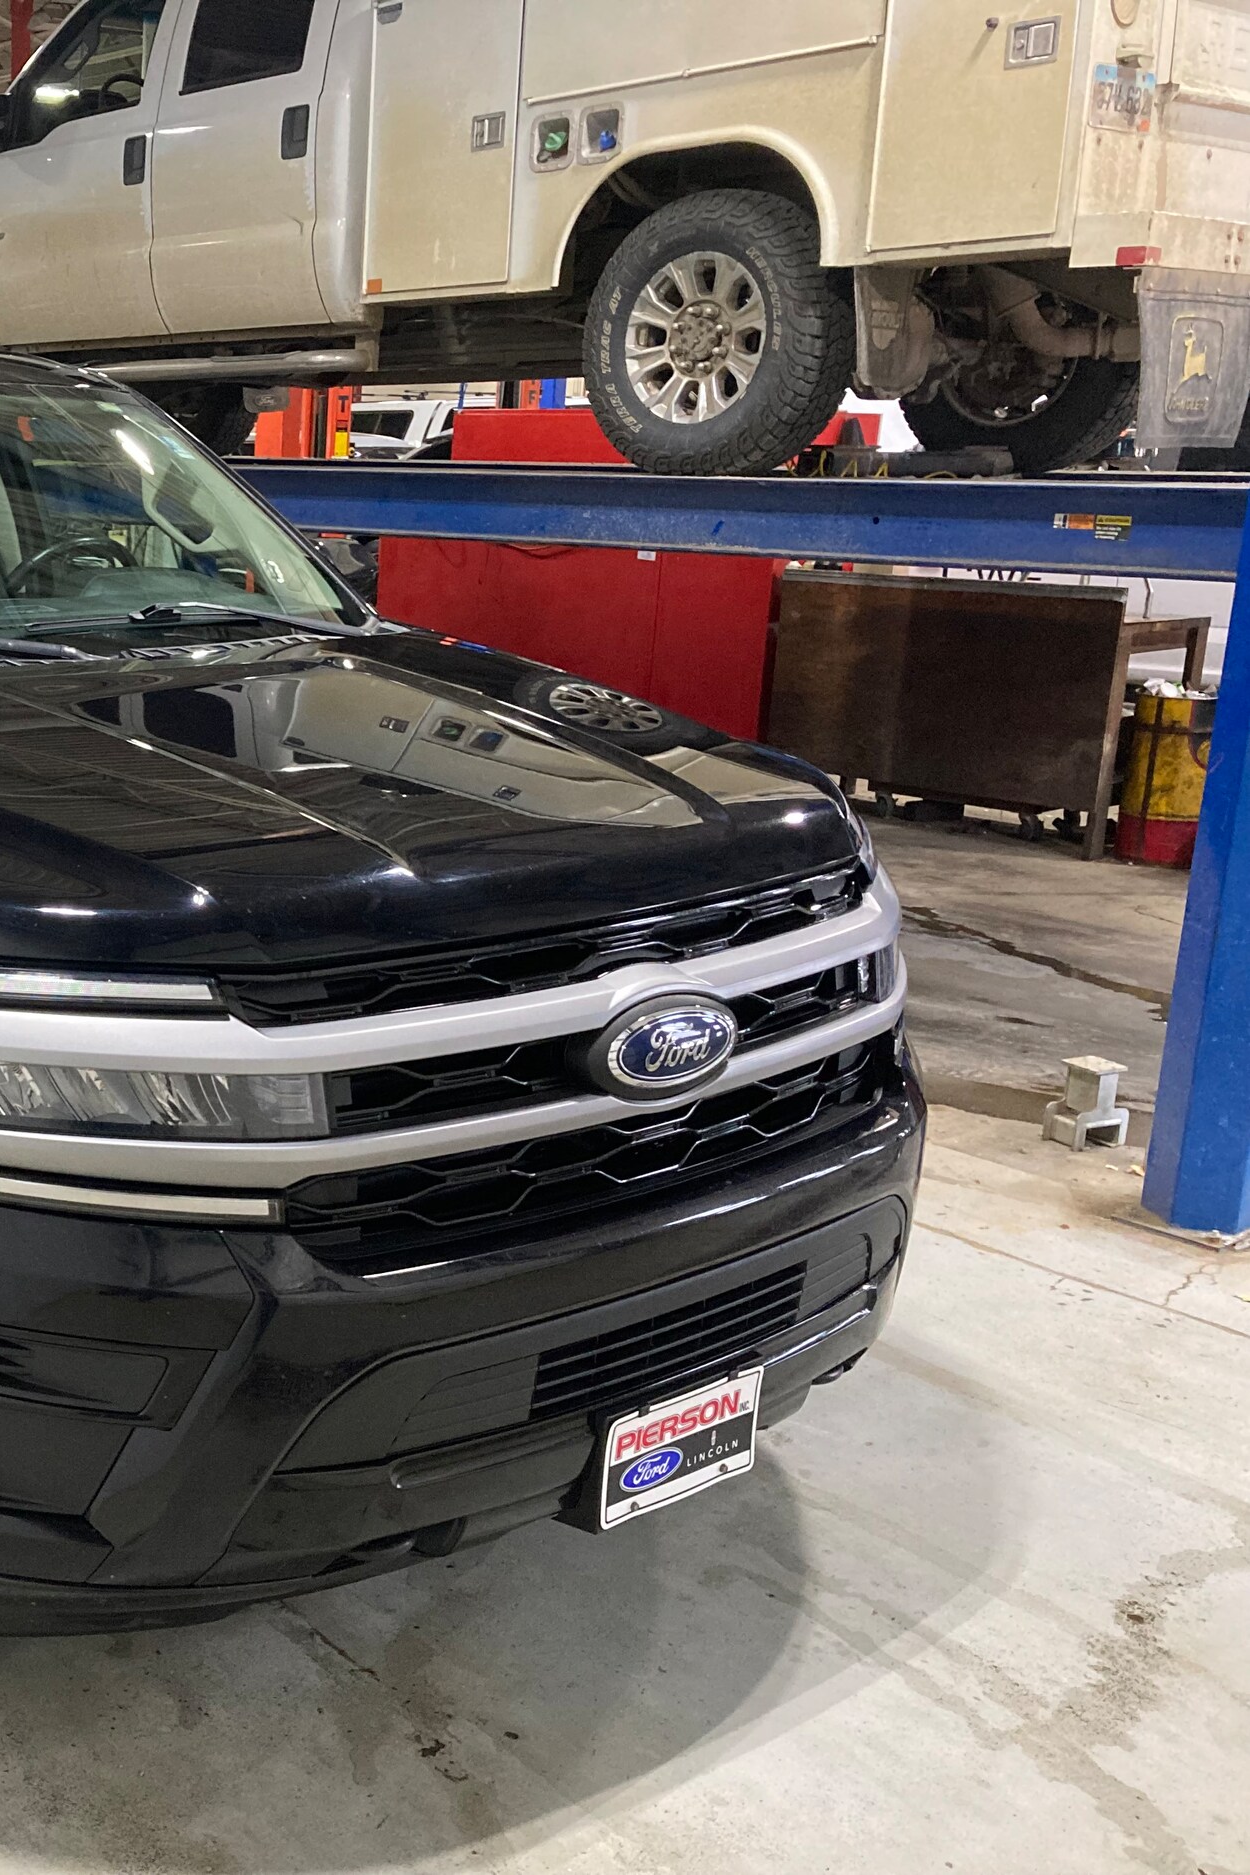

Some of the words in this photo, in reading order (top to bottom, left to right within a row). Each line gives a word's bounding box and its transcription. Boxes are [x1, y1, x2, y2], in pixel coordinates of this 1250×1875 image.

[609, 286, 622, 316] AT
[745, 246, 783, 352] HERCULES
[600, 319, 613, 375] TRAC
[606, 384, 643, 434] TERRA
[645, 1021, 712, 1073] Ford
[614, 1389, 741, 1461] PIERSON
[739, 1400, 750, 1413] INC.
[632, 1454, 671, 1486] Ford
[686, 1438, 740, 1468] LINCOLN
